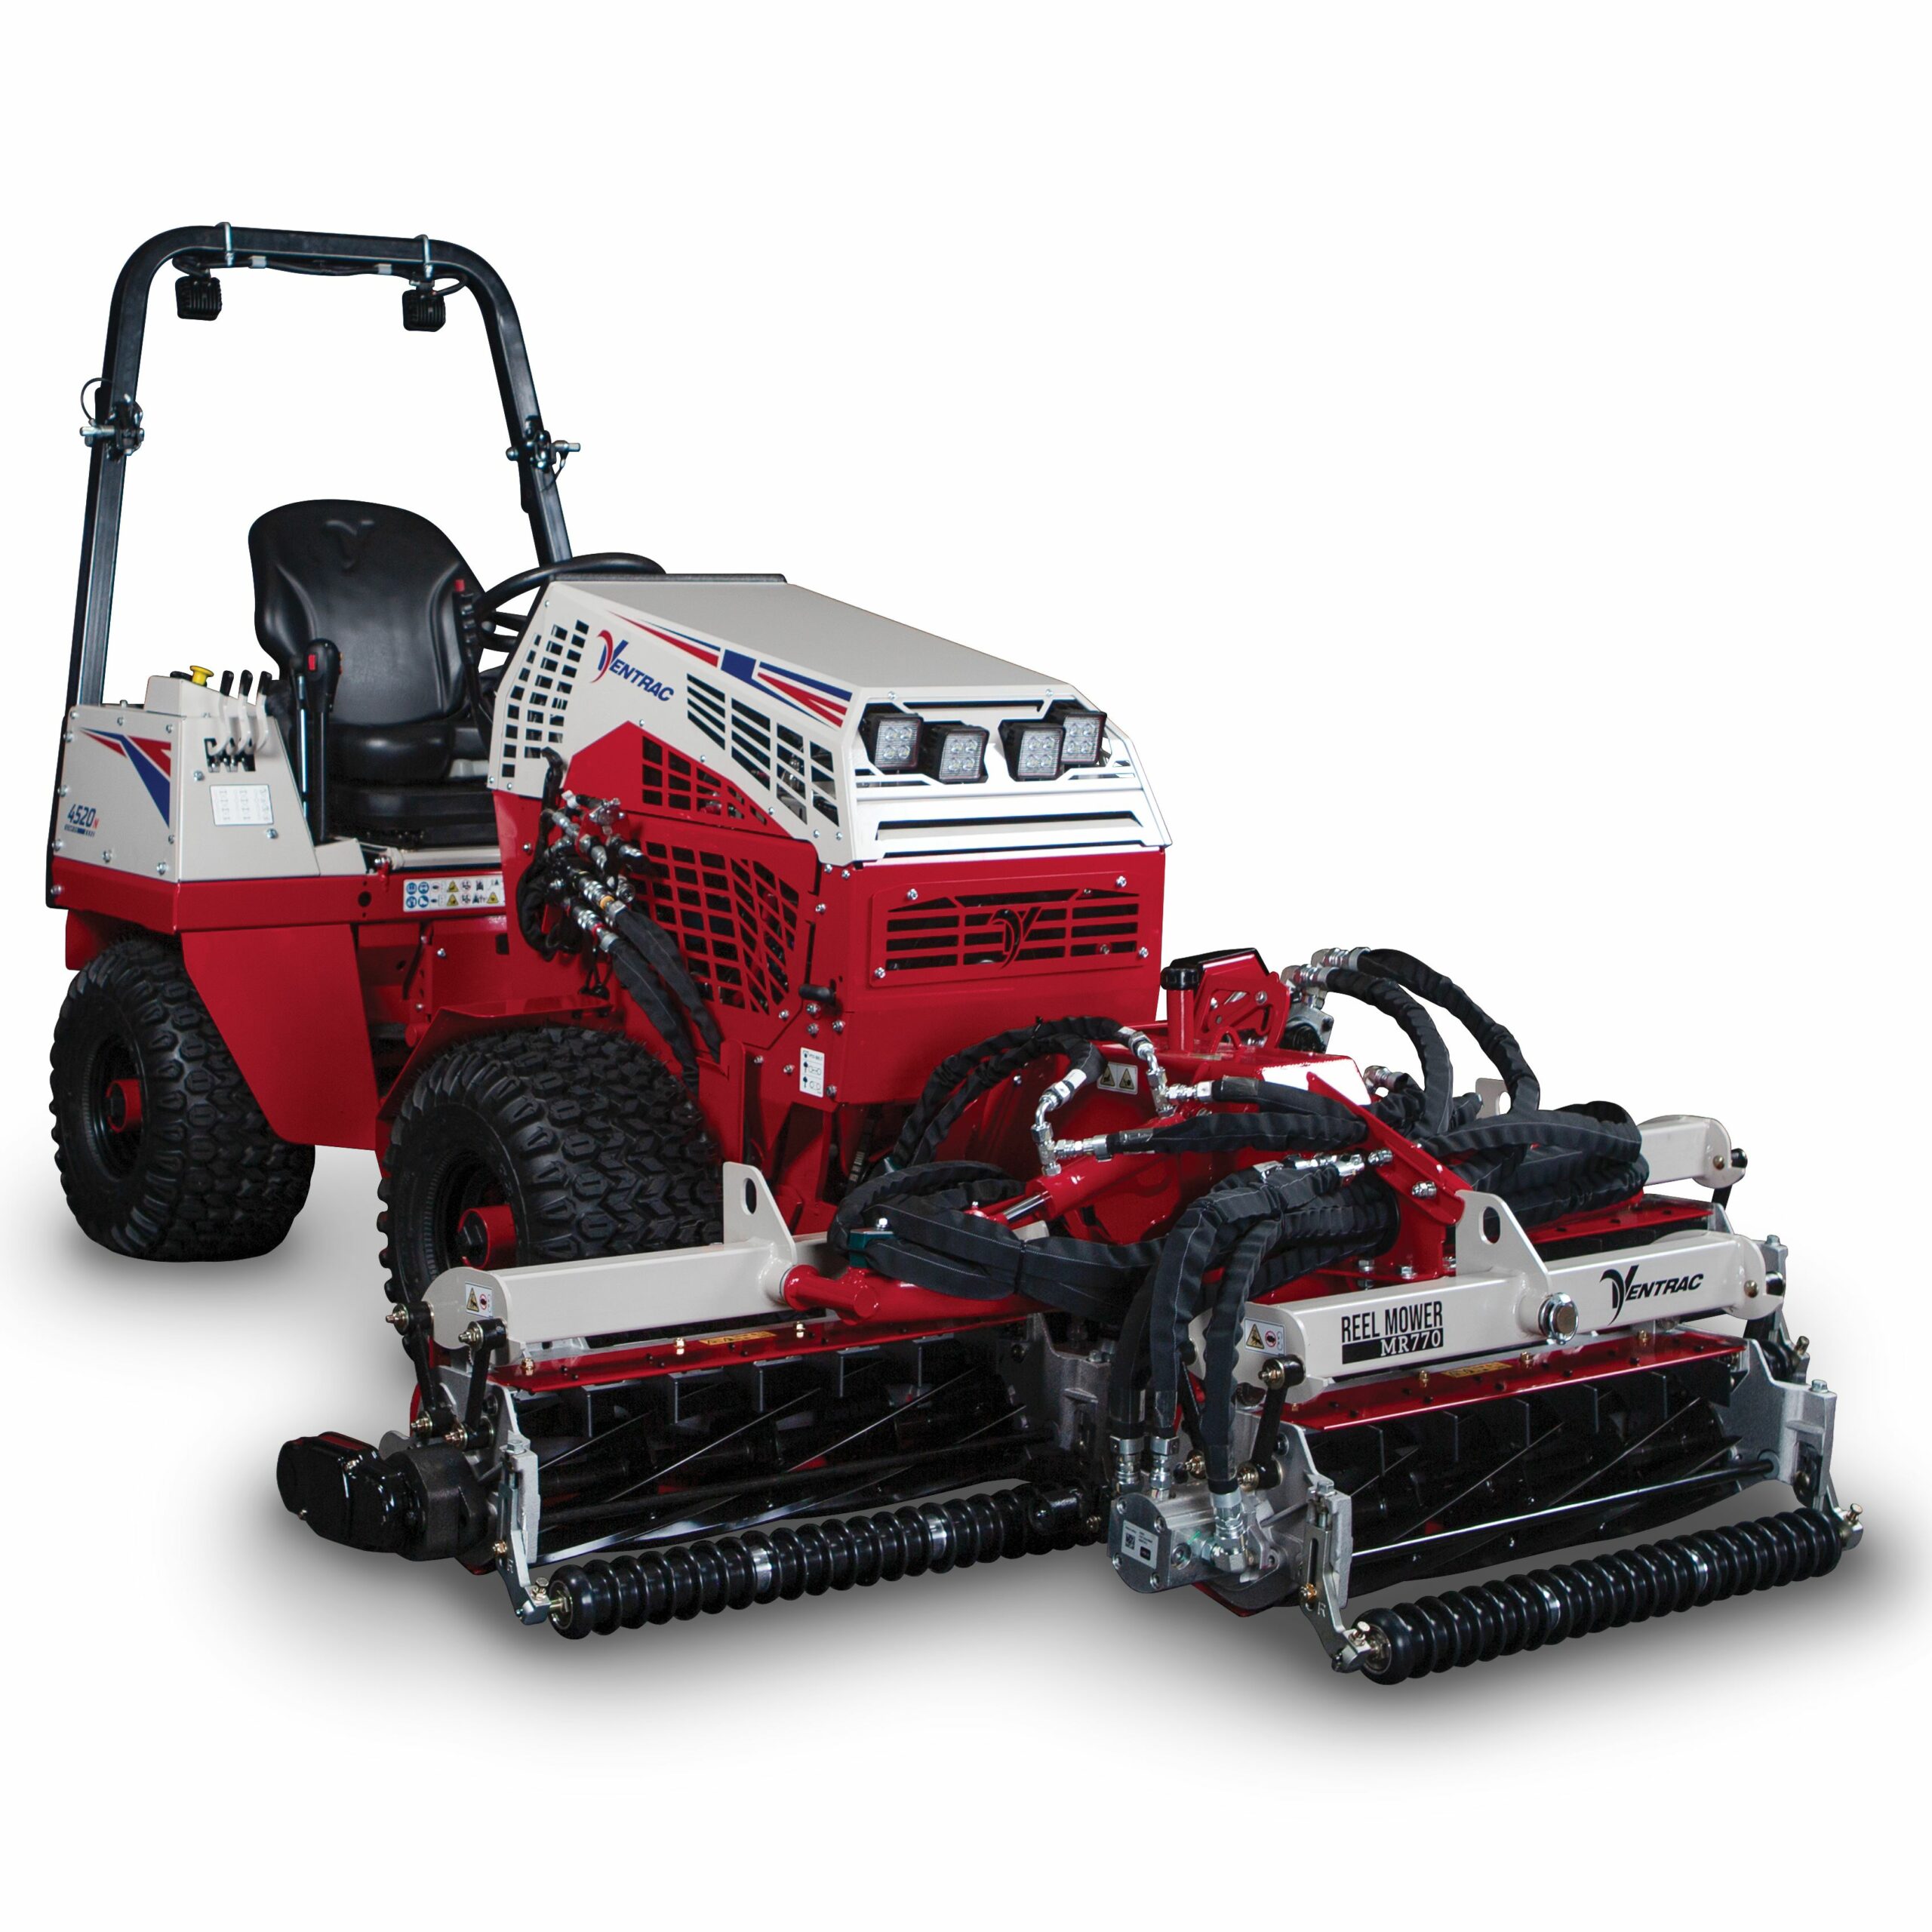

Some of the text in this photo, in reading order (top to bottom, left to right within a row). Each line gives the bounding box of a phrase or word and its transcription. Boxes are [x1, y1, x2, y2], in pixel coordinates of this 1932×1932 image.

[589, 629, 675, 702] VENTRAC
[1599, 1264, 1703, 1326] VENTRAC
[1341, 1300, 1443, 1343] REEL MOWER
[1380, 1330, 1441, 1356] MR770
